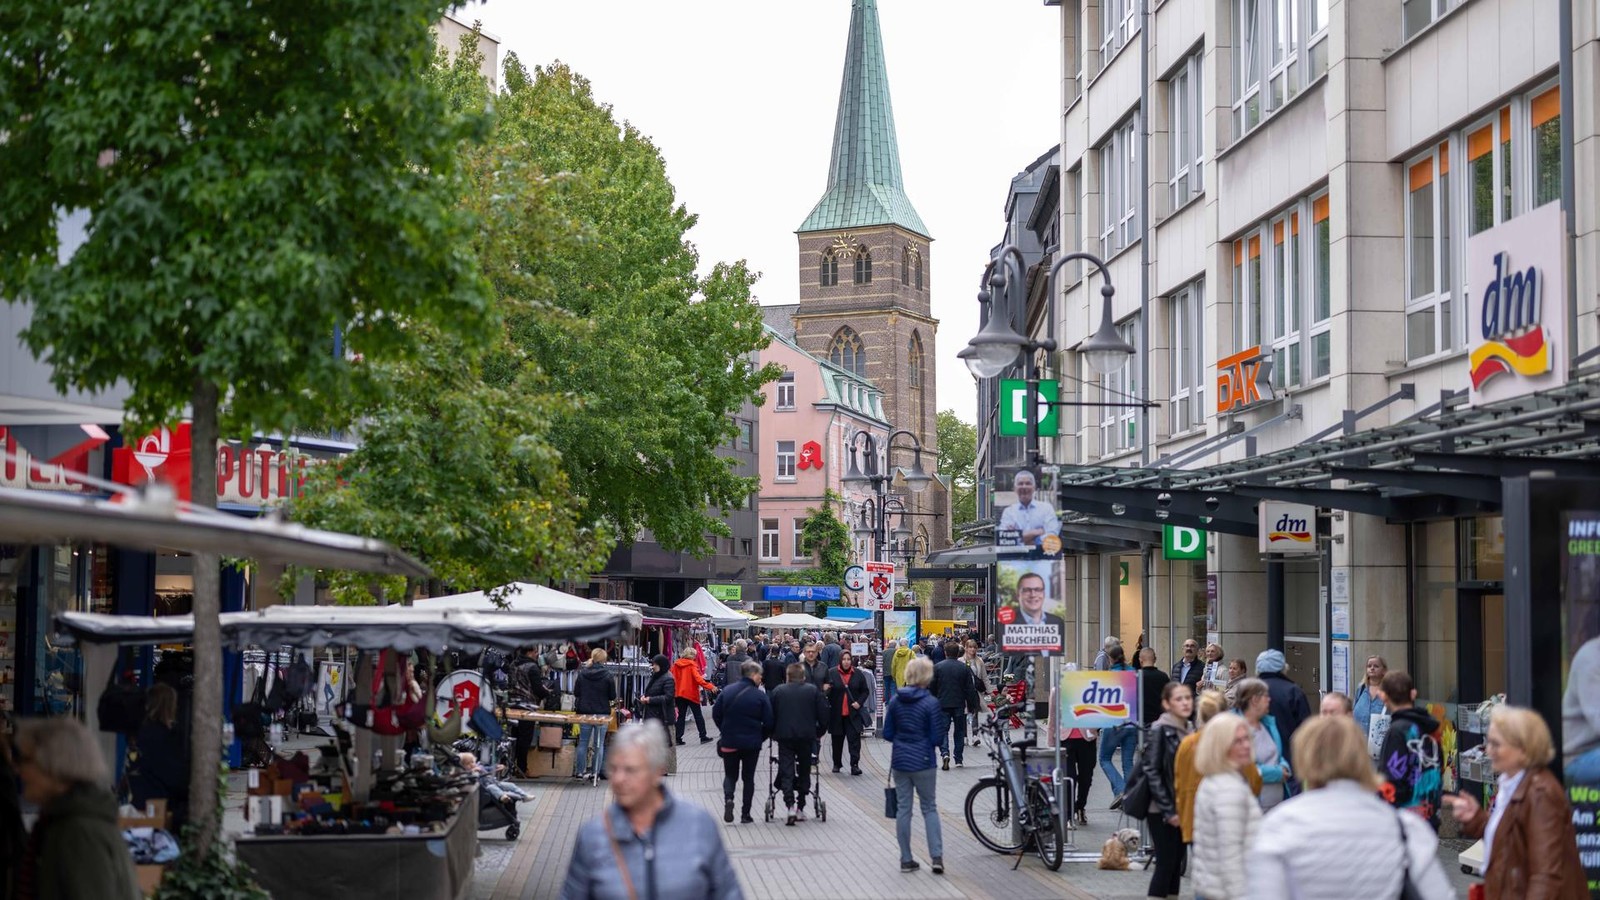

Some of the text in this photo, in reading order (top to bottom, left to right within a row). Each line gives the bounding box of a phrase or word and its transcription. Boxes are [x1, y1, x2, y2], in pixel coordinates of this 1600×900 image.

[1481, 250, 1542, 340] dm
[1216, 345, 1262, 413] DAK
[1276, 513, 1307, 532] dm
[1173, 525, 1200, 553] D
[726, 588, 738, 597] RISSE
[1007, 626, 1056, 634] MATTHIAS
[1005, 636, 1058, 644] BUSCHFELD
[1082, 681, 1121, 704] dm
[1570, 786, 1600, 802] Wo
[1572, 808, 1594, 825] Am
